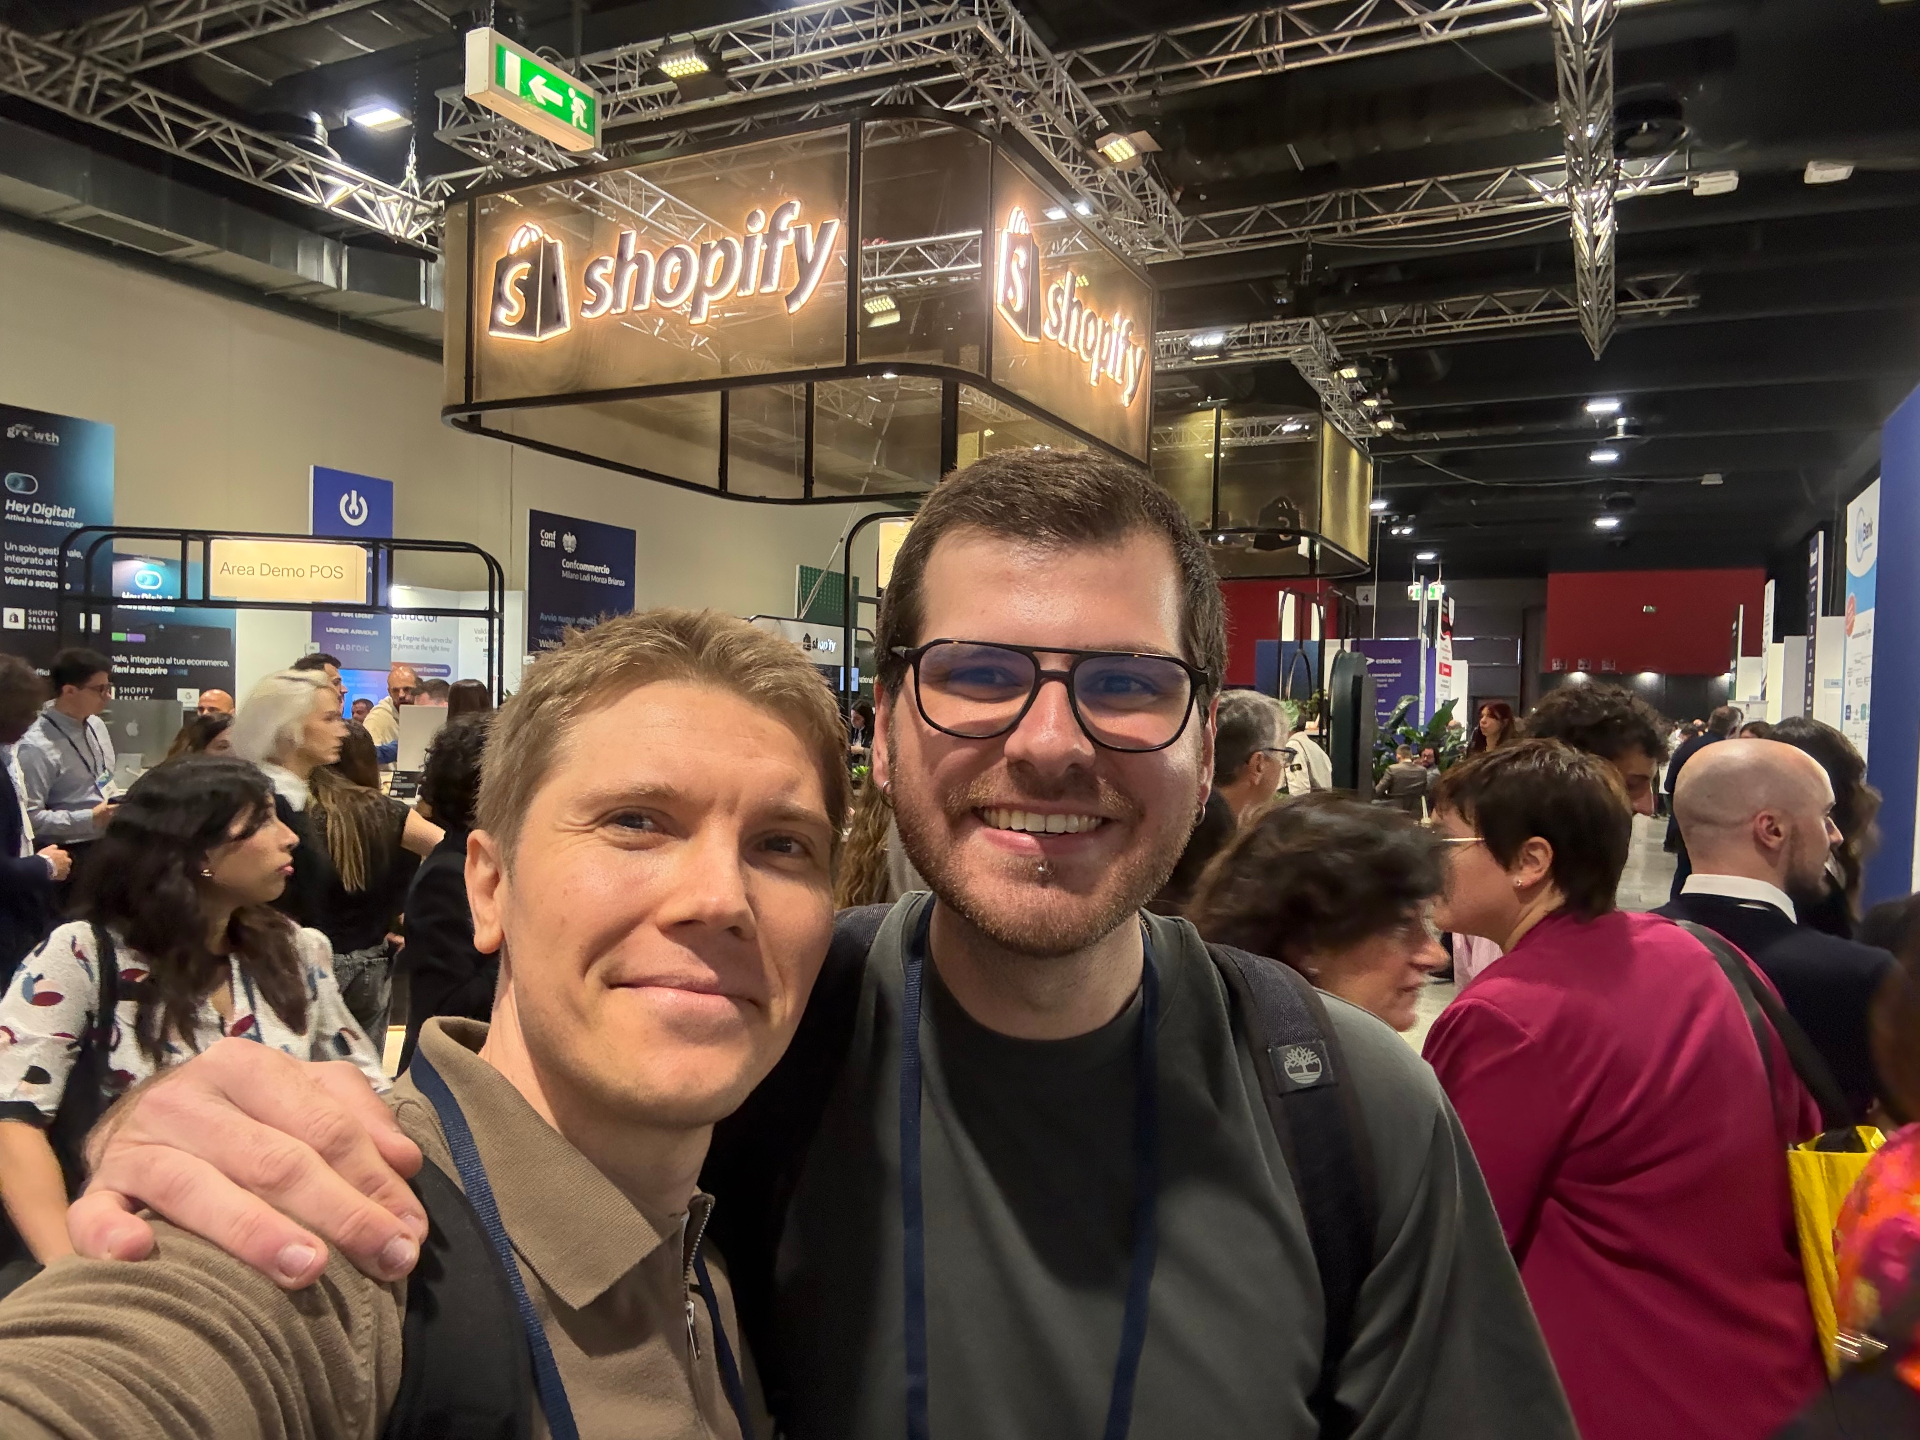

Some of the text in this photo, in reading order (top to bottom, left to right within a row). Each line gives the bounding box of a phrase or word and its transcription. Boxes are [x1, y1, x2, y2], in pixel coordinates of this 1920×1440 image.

[580, 200, 840, 325] shopify
[1043, 270, 1147, 408] shopify
[5, 499, 76, 519] Hey Digital!
[540, 529, 556, 540] Conf
[4, 542, 17, 551] Un
[18, 544, 37, 553] solo
[540, 540, 556, 549] com
[4, 553, 44, 565] integrato
[45, 558, 52, 566] al
[4, 566, 58, 577] ecommerce.
[220, 561, 344, 579] Area Demo POS
[561, 559, 610, 574] Confcommercio
[4, 576, 27, 586] Vieni
[28, 616, 55, 624] SELECT
[28, 624, 56, 632] PARTNE
[350, 628, 379, 636] ARMOUR
[130, 655, 165, 665] integrato
[165, 656, 173, 664] al
[186, 658, 230, 667] ecommerce.
[136, 667, 168, 676] scoprire
[119, 686, 154, 694] SHOPIFY
